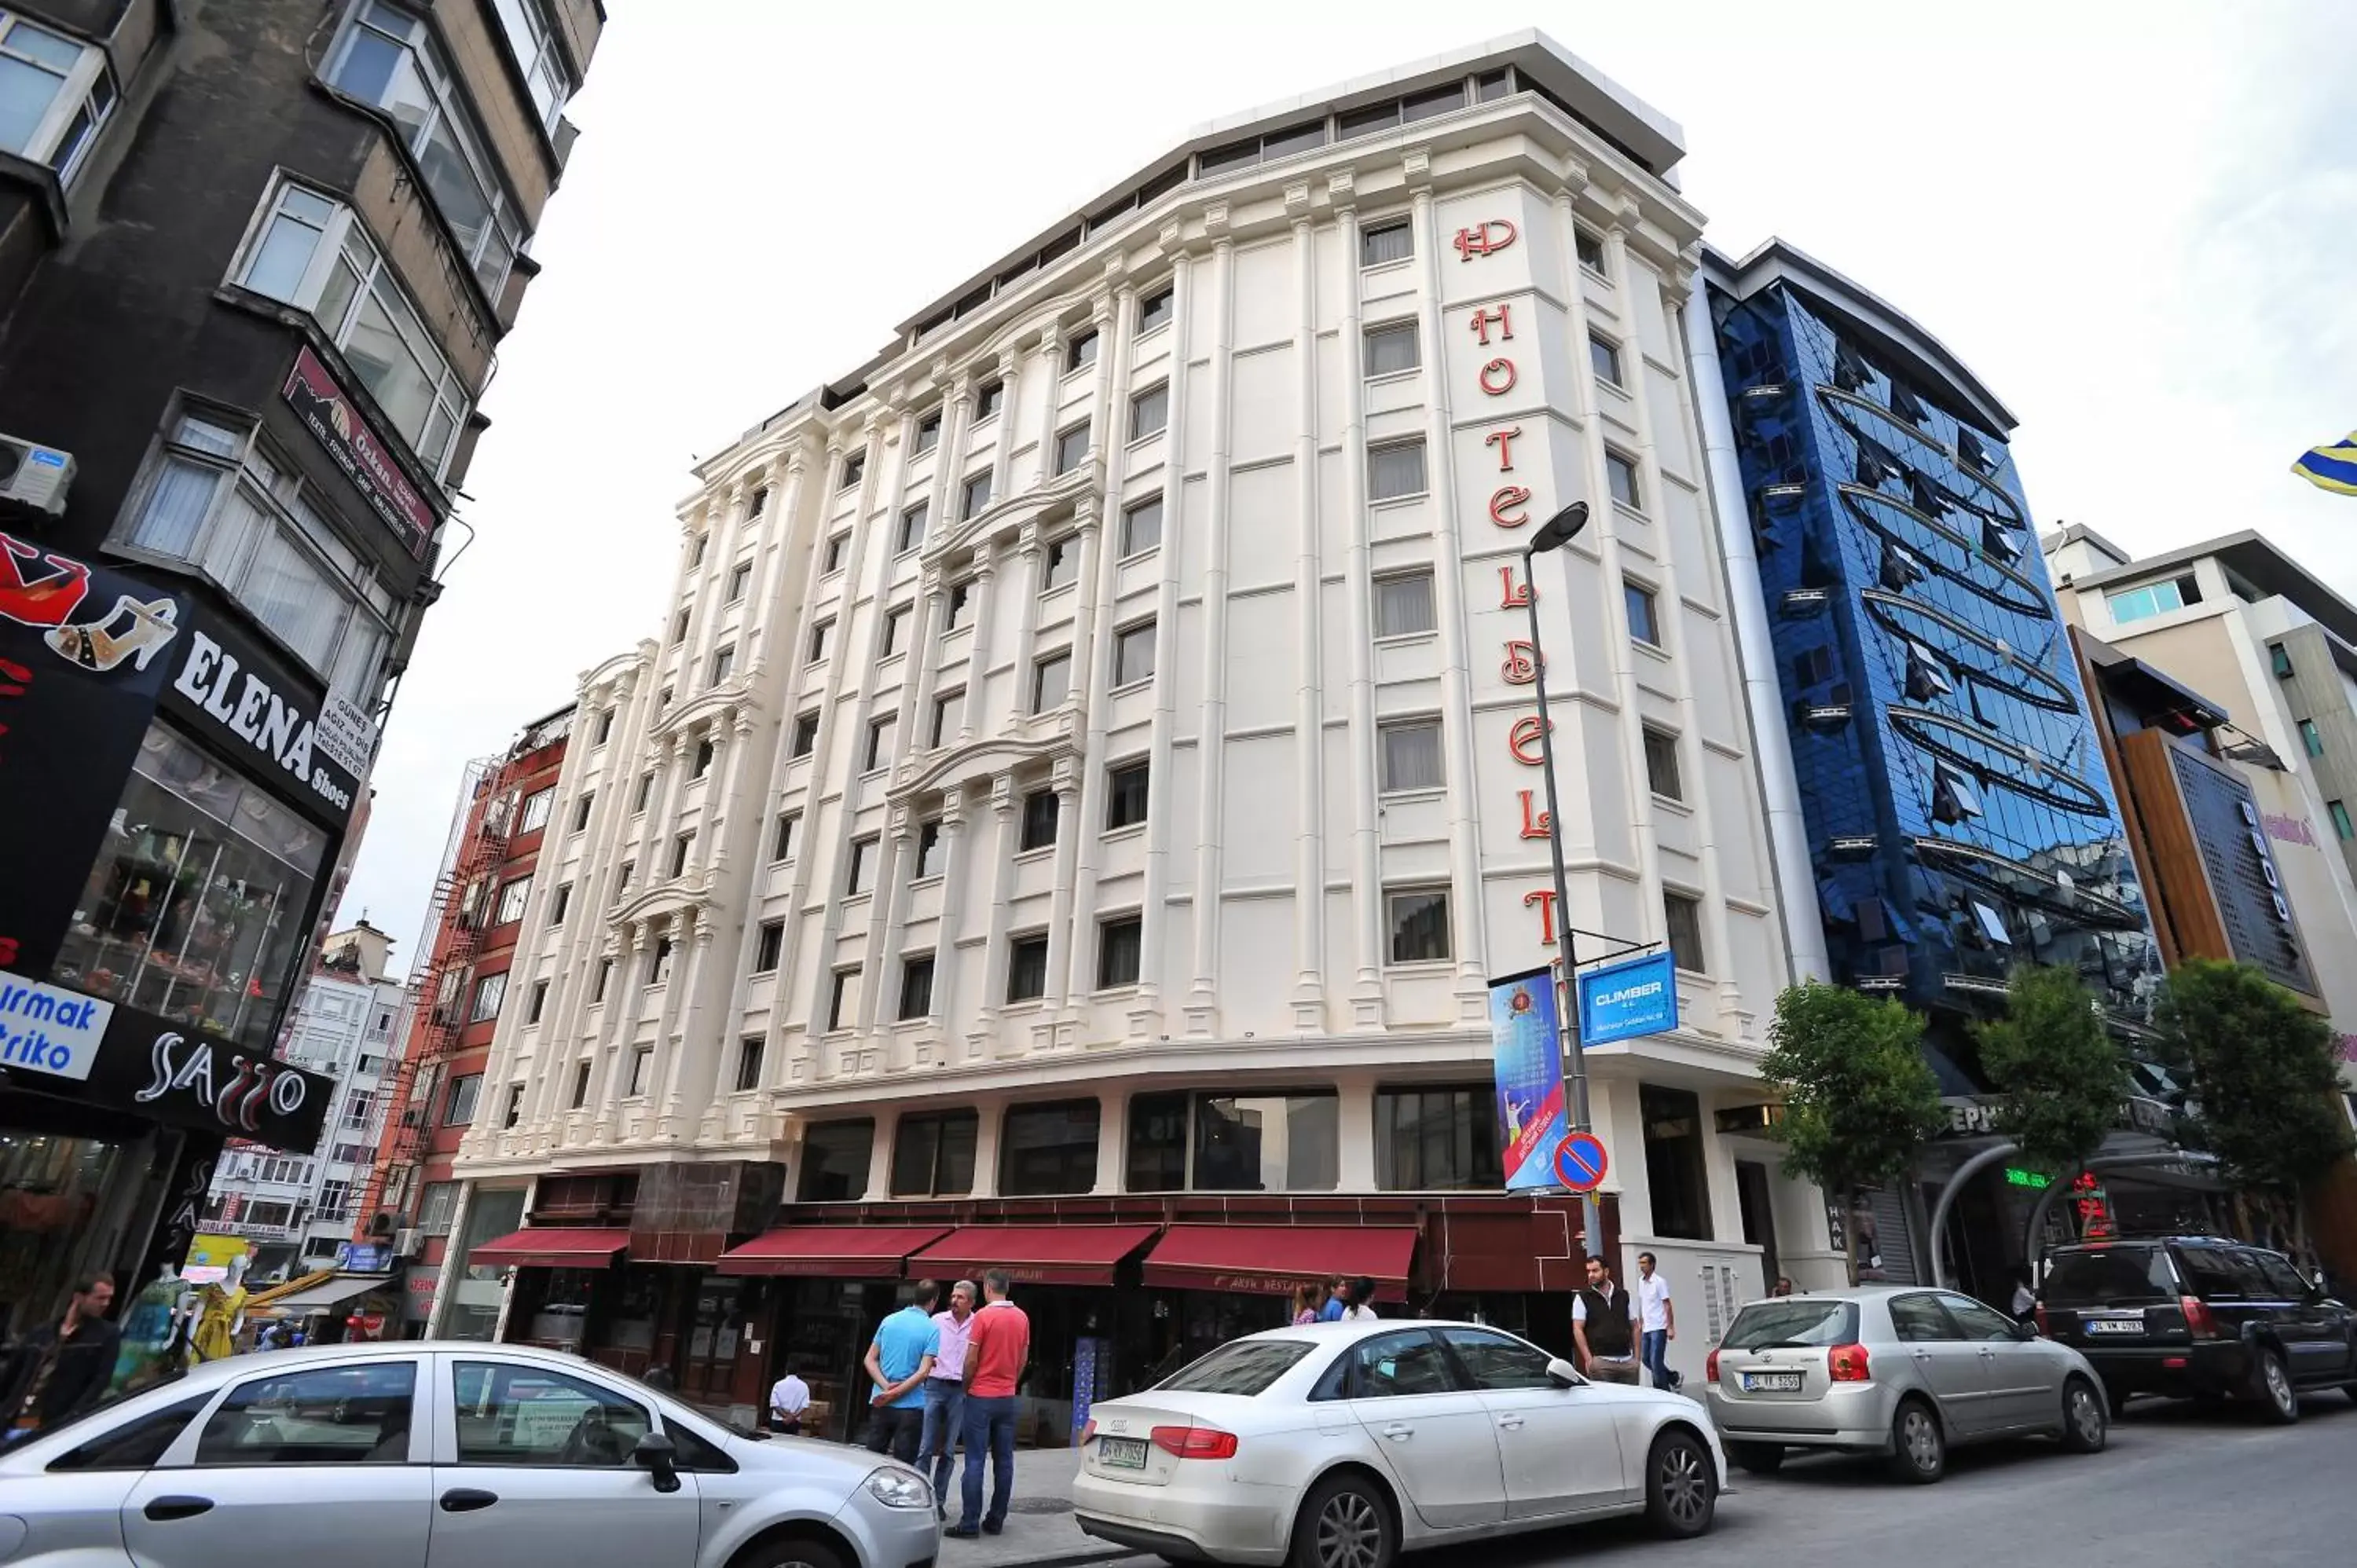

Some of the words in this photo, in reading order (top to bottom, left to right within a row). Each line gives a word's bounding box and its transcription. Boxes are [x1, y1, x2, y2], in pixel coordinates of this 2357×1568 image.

[1471, 303, 1540, 609] HOTEL
[174, 631, 313, 782] ELENA
[312, 768, 350, 810] Shoes
[1501, 641, 1563, 966] DELT
